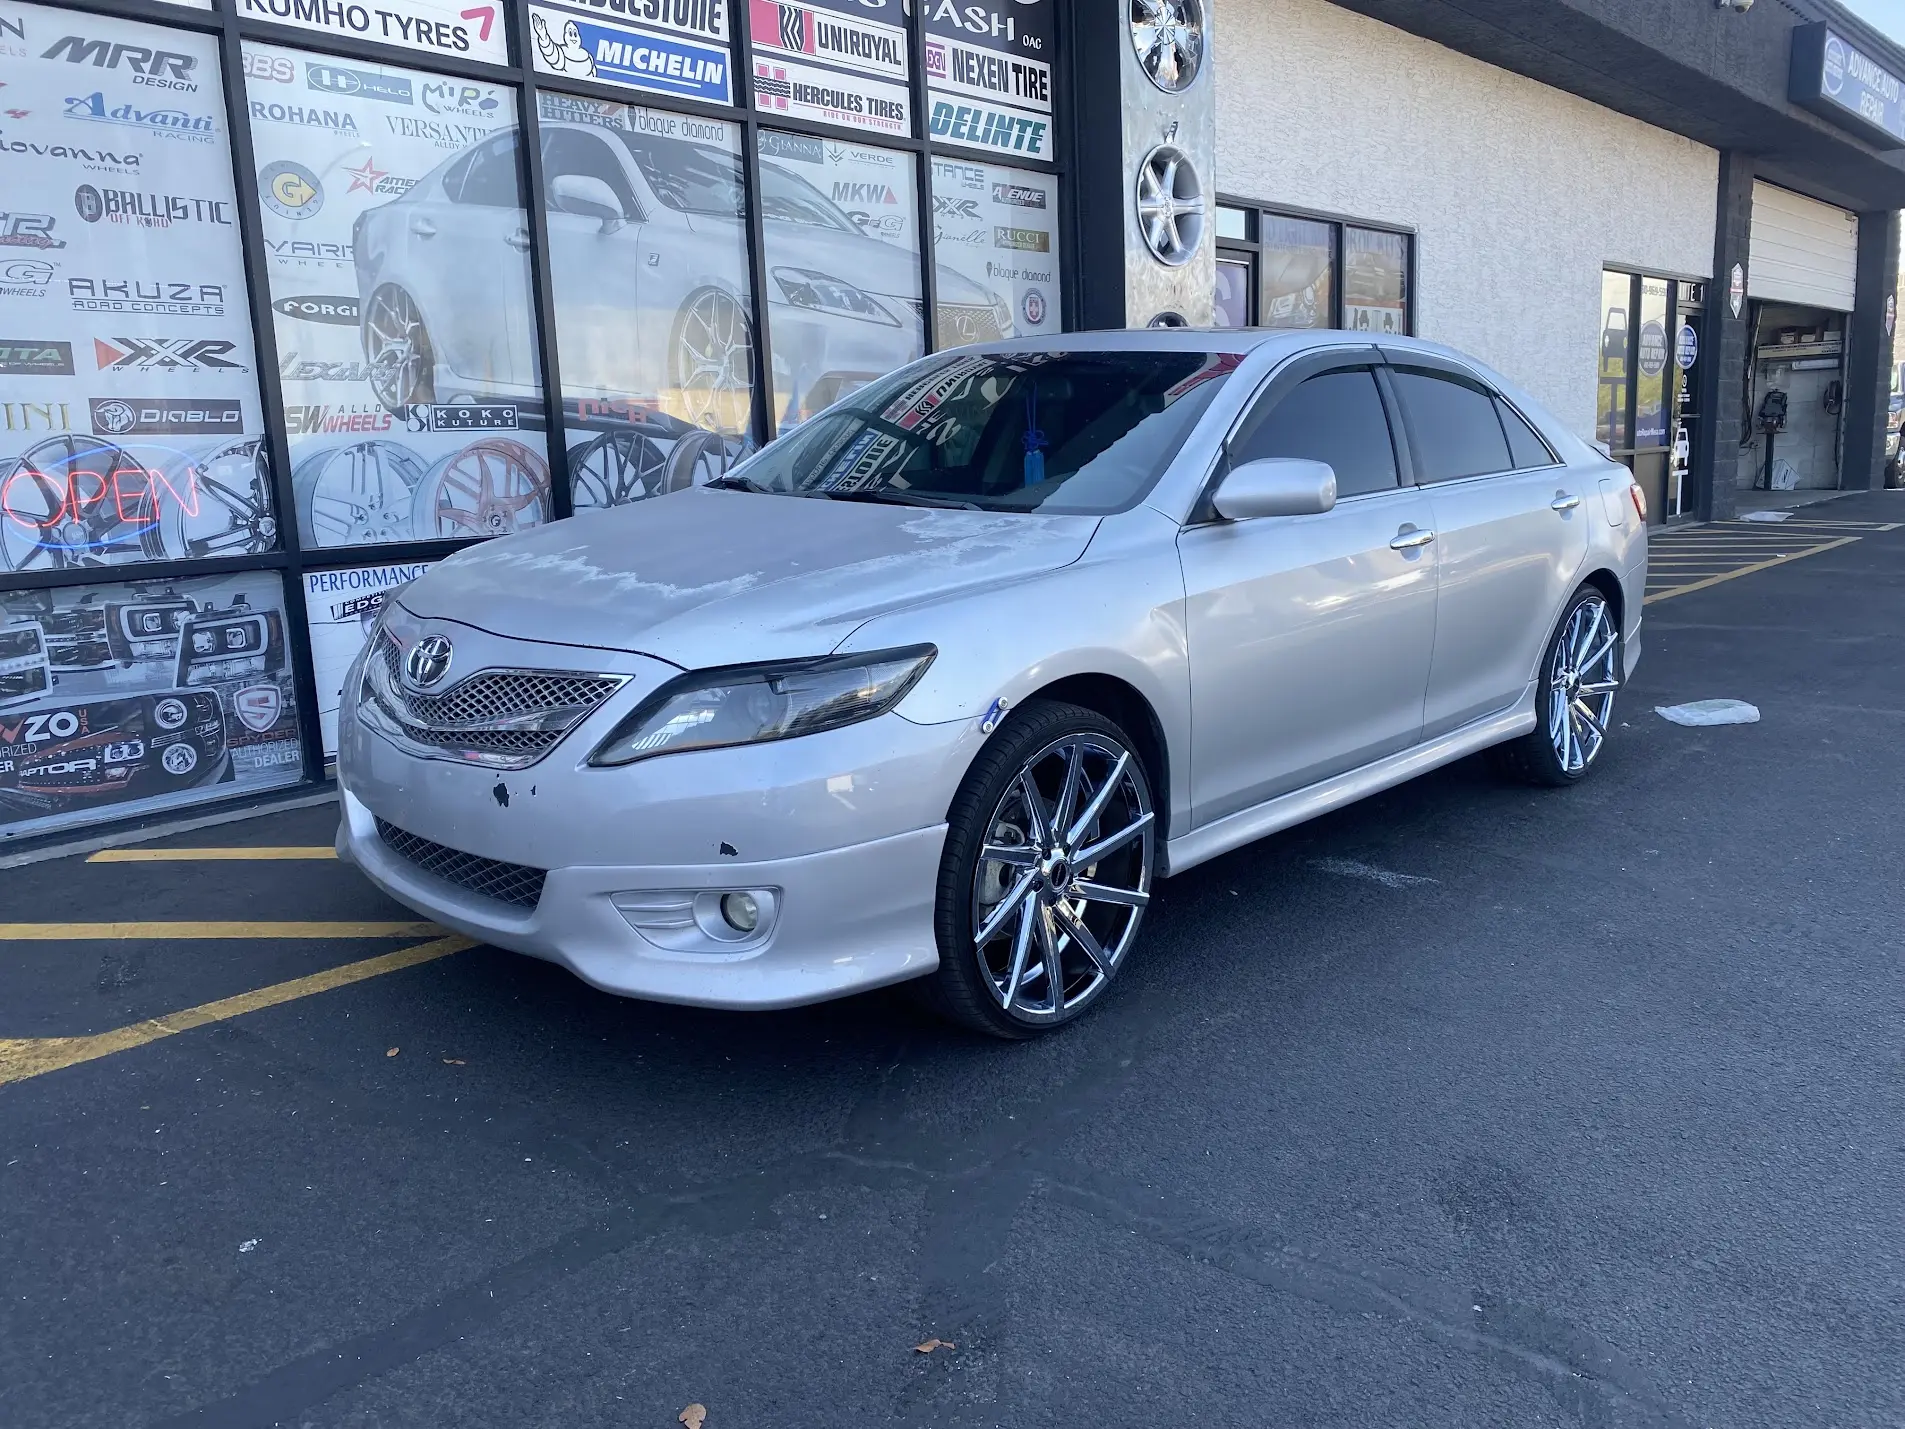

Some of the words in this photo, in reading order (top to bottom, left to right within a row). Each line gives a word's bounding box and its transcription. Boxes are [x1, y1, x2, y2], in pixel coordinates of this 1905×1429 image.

[375, 10, 470, 51] TYRES
[925, 0, 1015, 41] ASH
[818, 22, 902, 66] UNIROYAL
[1022, 34, 1042, 50] OAC
[40, 36, 198, 81] MRR
[596, 39, 724, 85] MICHELIN
[132, 75, 198, 93] DESIGN
[952, 48, 1009, 93] NEXEN
[1012, 63, 1048, 102] TIRE
[1848, 51, 1882, 92] ADVANCE
[1880, 74, 1899, 103] AUTO
[64, 92, 214, 131] Advanti
[444, 105, 495, 118] WHEELS
[540, 95, 601, 114] HEAVY
[793, 82, 863, 113] HERCULES
[866, 97, 904, 121] TIRES
[1860, 91, 1884, 125] REPAIR
[251, 101, 357, 130] ROHANA
[541, 108, 624, 129] HITTERS
[153, 130, 215, 144] RACING
[681, 120, 724, 142] diamond
[930, 101, 1047, 153] DELINTE
[0, 130, 141, 166] iovanna
[769, 136, 823, 159] GIANNA
[850, 151, 893, 164] VERDE
[82, 164, 140, 176] WHEELS
[931, 162, 984, 183] TANCE
[831, 181, 886, 203] MKW
[101, 188, 232, 226] BALLISTIC
[997, 229, 1040, 244] RUCCI
[993, 263, 1019, 281] blaque
[1022, 268, 1051, 283] diamond
[68, 277, 224, 302] AKUZA
[72, 301, 123, 310] ROAD
[131, 303, 225, 315] CONCEPTS
[111, 337, 246, 368] XXR
[140, 409, 240, 424] DIABLO
[323, 414, 393, 433] WHEELS
[436, 409, 515, 419] KOKO
[437, 419, 515, 427] KUTURE
[3, 467, 199, 528] OPEN
[78, 709, 90, 734] USA
[226, 728, 297, 747] SPYDER
[231, 738, 299, 760] AUTHORIZED
[254, 750, 300, 768] DEALER
